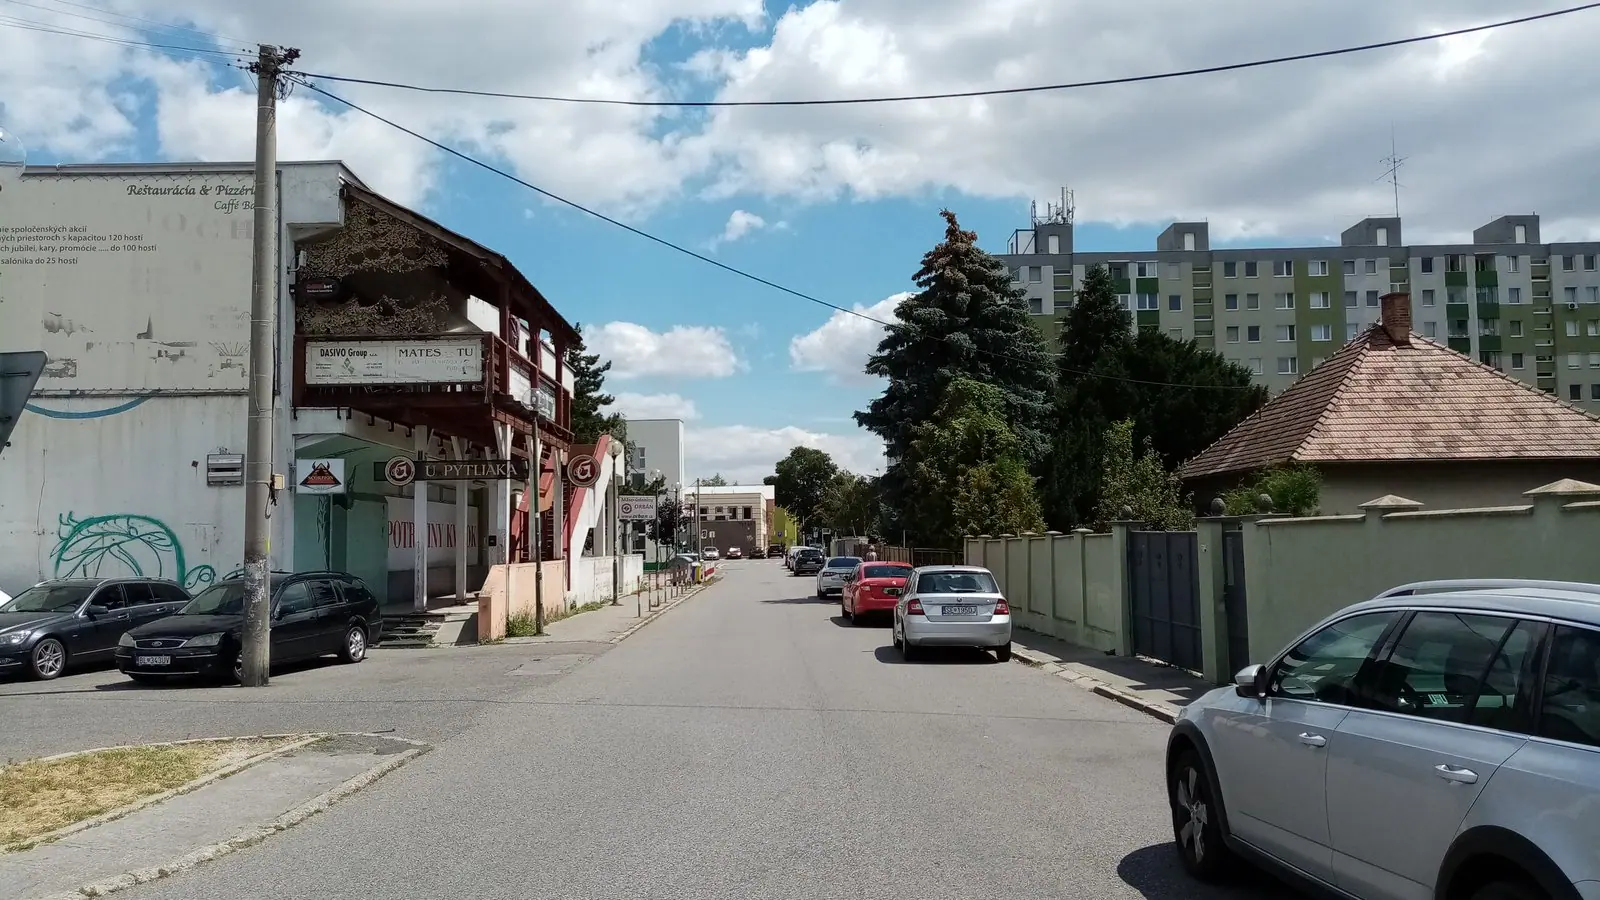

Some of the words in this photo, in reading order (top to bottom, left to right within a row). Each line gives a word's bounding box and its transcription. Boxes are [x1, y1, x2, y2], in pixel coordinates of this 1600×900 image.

[199, 185, 212, 196] &
[215, 185, 255, 196] Pizzéri
[214, 200, 239, 214] Caffé
[242, 201, 255, 210] Ba
[11, 226, 67, 235] spoločenských
[69, 225, 87, 233] akcií
[17, 235, 61, 243] priestoroch
[68, 235, 107, 243] kapacitou
[109, 234, 123, 242] 120
[124, 234, 144, 242] hostí
[60, 244, 97, 253] promócie
[111, 244, 121, 252] do
[123, 244, 137, 252] 100
[1, 257, 34, 265] salónika
[35, 257, 45, 265] do
[46, 257, 56, 265] 25
[320, 348, 346, 357] DASIVO
[348, 348, 368, 358] Group
[399, 348, 442, 357] MATES
[426, 465, 436, 477] U
